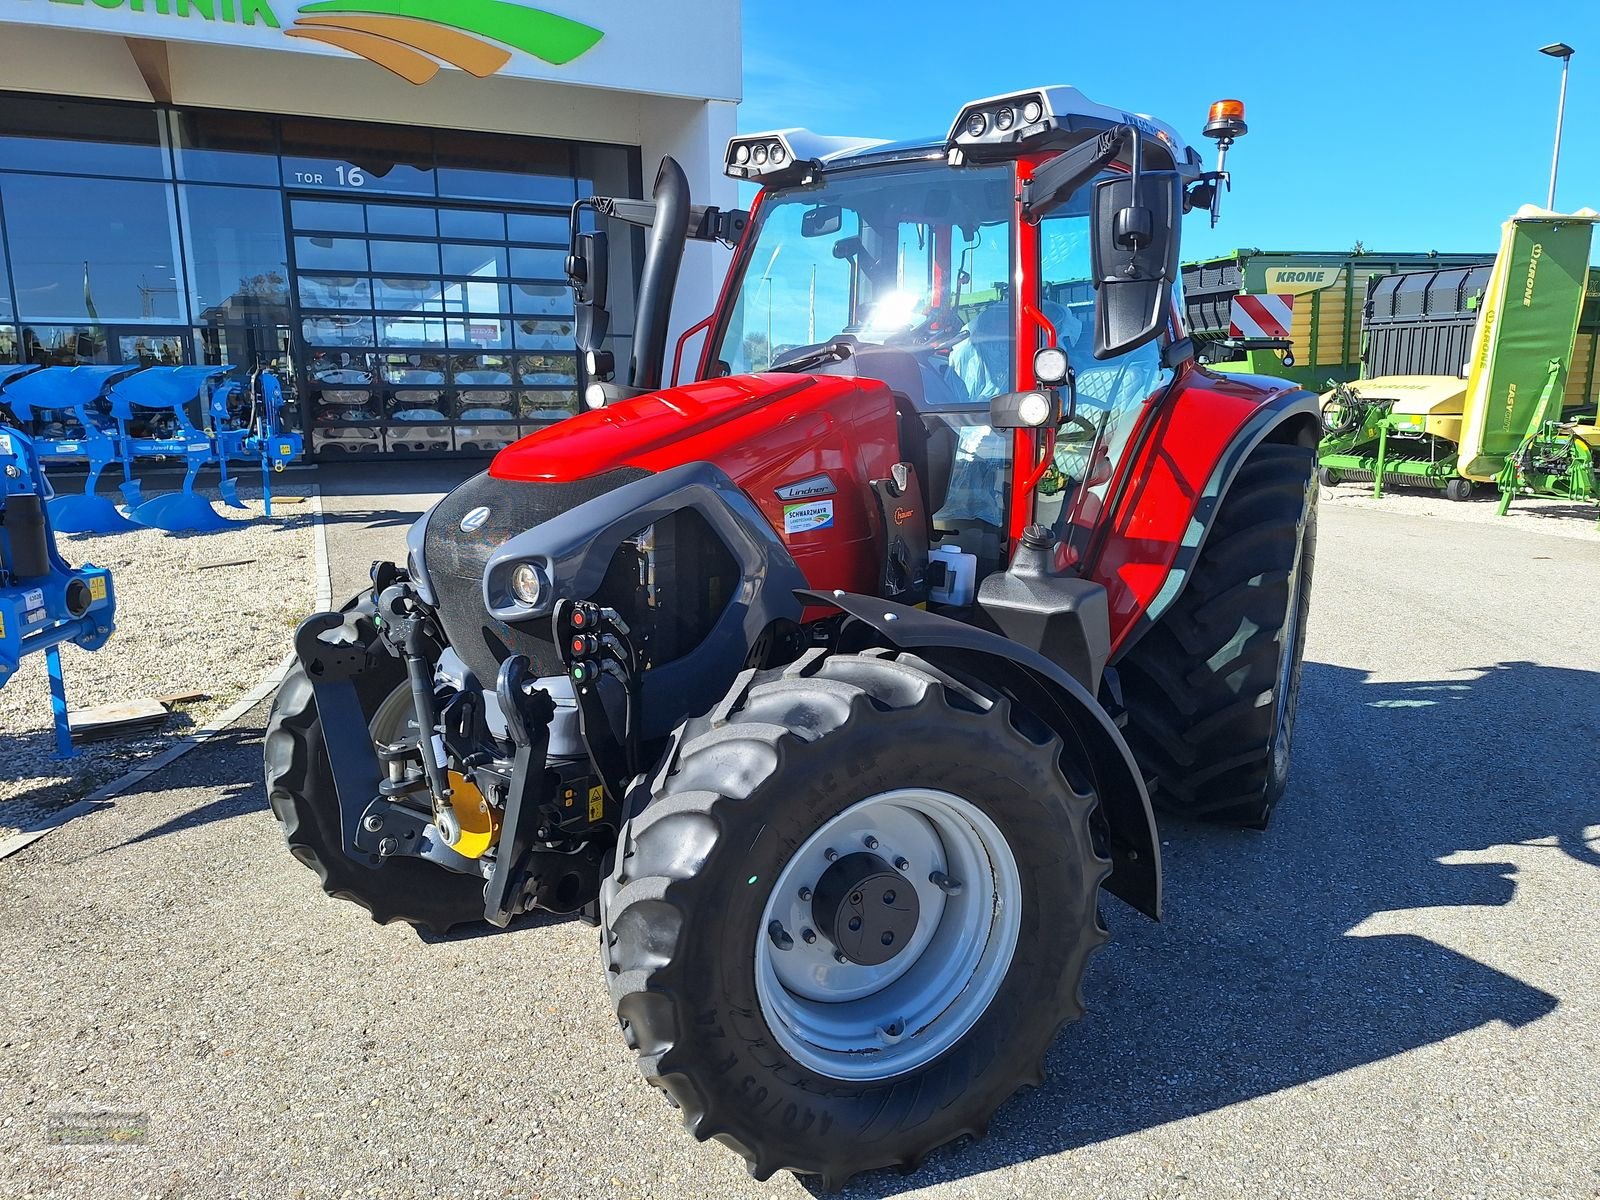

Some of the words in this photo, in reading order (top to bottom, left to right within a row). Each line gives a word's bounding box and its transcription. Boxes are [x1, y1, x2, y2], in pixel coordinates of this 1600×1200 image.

[295, 172, 323, 184] TOR
[336, 166, 365, 187] 16
[1275, 271, 1325, 283] KRONE
[1523, 258, 1538, 308] KRONE
[1479, 324, 1493, 370] KRONE
[788, 486, 829, 497] Lindner
[789, 507, 828, 519] SCHWARZMAYR
